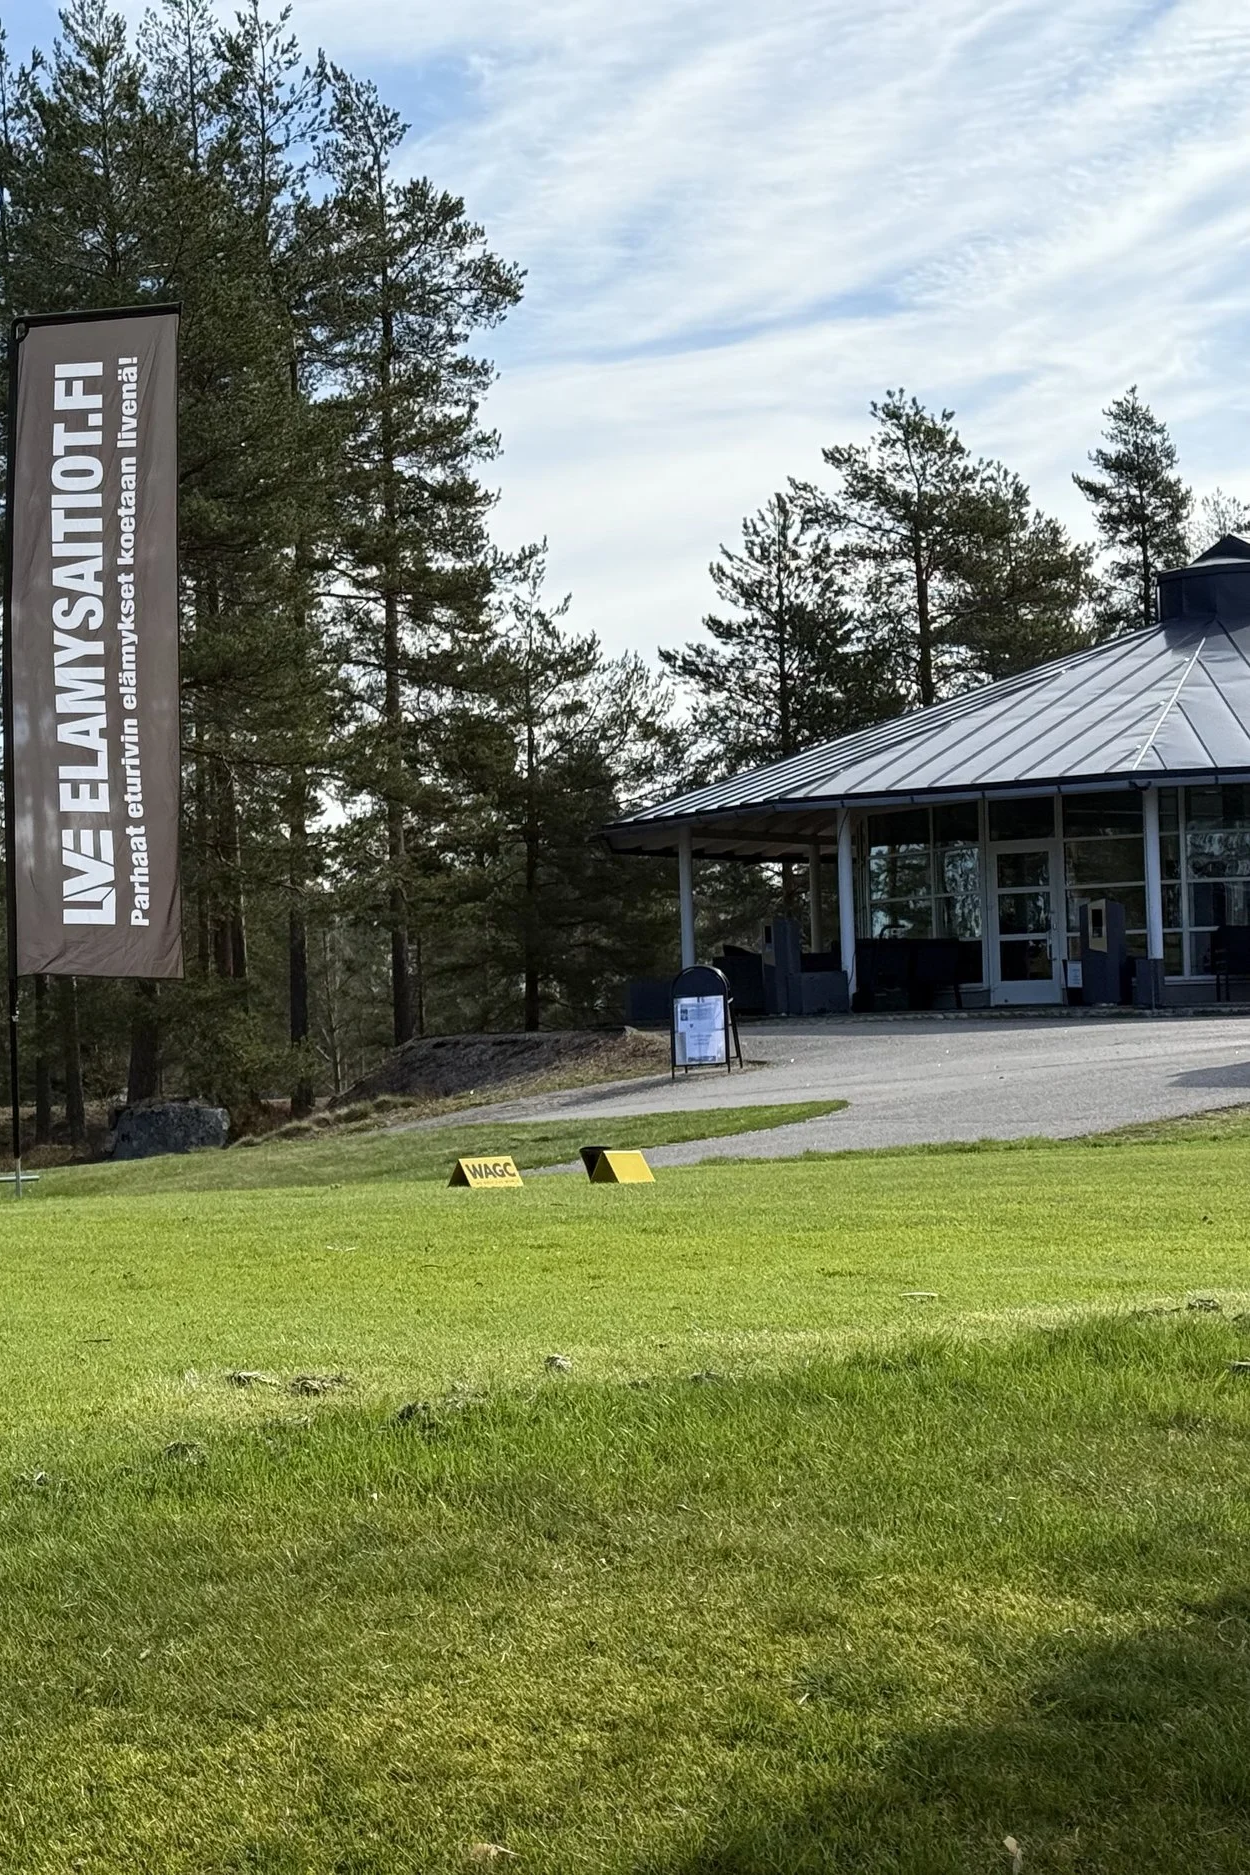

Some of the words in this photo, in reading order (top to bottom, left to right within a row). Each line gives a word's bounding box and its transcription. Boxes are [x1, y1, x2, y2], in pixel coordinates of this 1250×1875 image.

[116, 356, 138, 448] livenä!
[116, 456, 137, 565] koetaan
[51, 361, 110, 813] ELAMYSAITIOT.FI
[117, 572, 139, 710] elämykset
[120, 718, 144, 818] eturivin
[125, 825, 150, 927] Parhaat
[465, 1162, 517, 1180] WAGC
